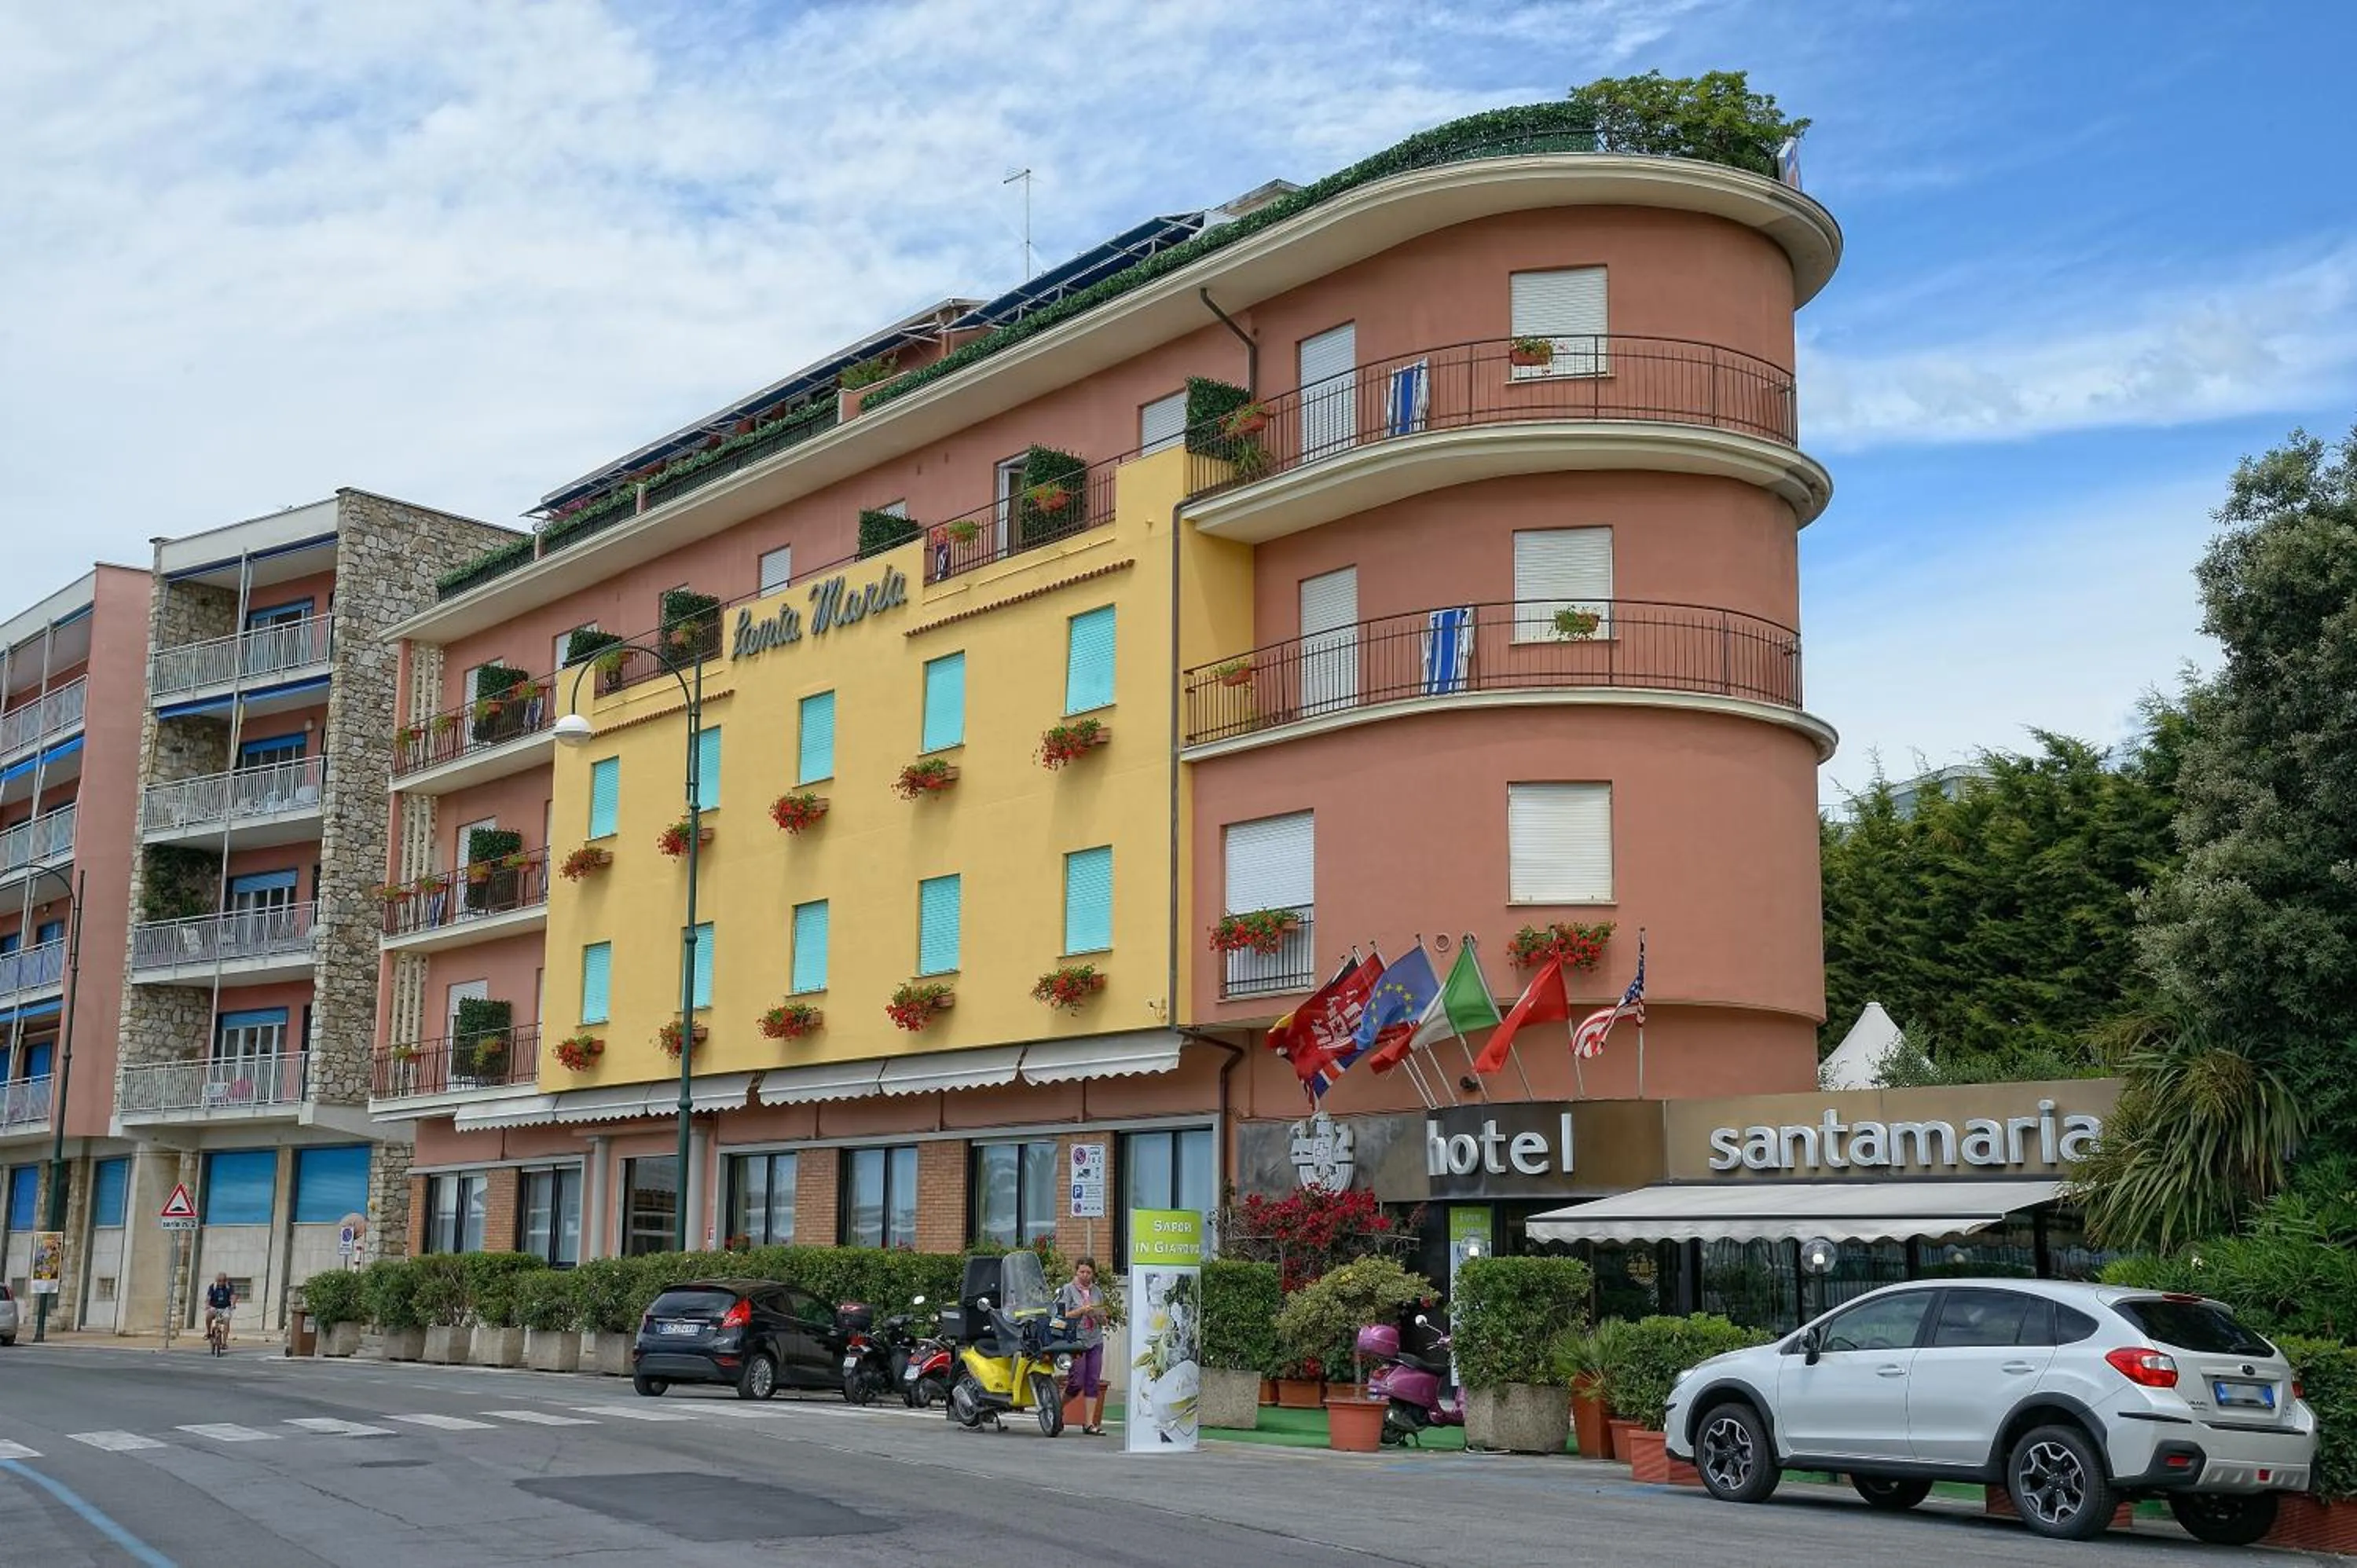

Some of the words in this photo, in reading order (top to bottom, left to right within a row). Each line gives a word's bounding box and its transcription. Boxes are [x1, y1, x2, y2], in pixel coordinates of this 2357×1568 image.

[808, 563, 907, 636] Maria
[1426, 1112, 1574, 1176] hotel
[1709, 1099, 2103, 1171] santamaria
[1135, 1242, 1149, 1253] IN
